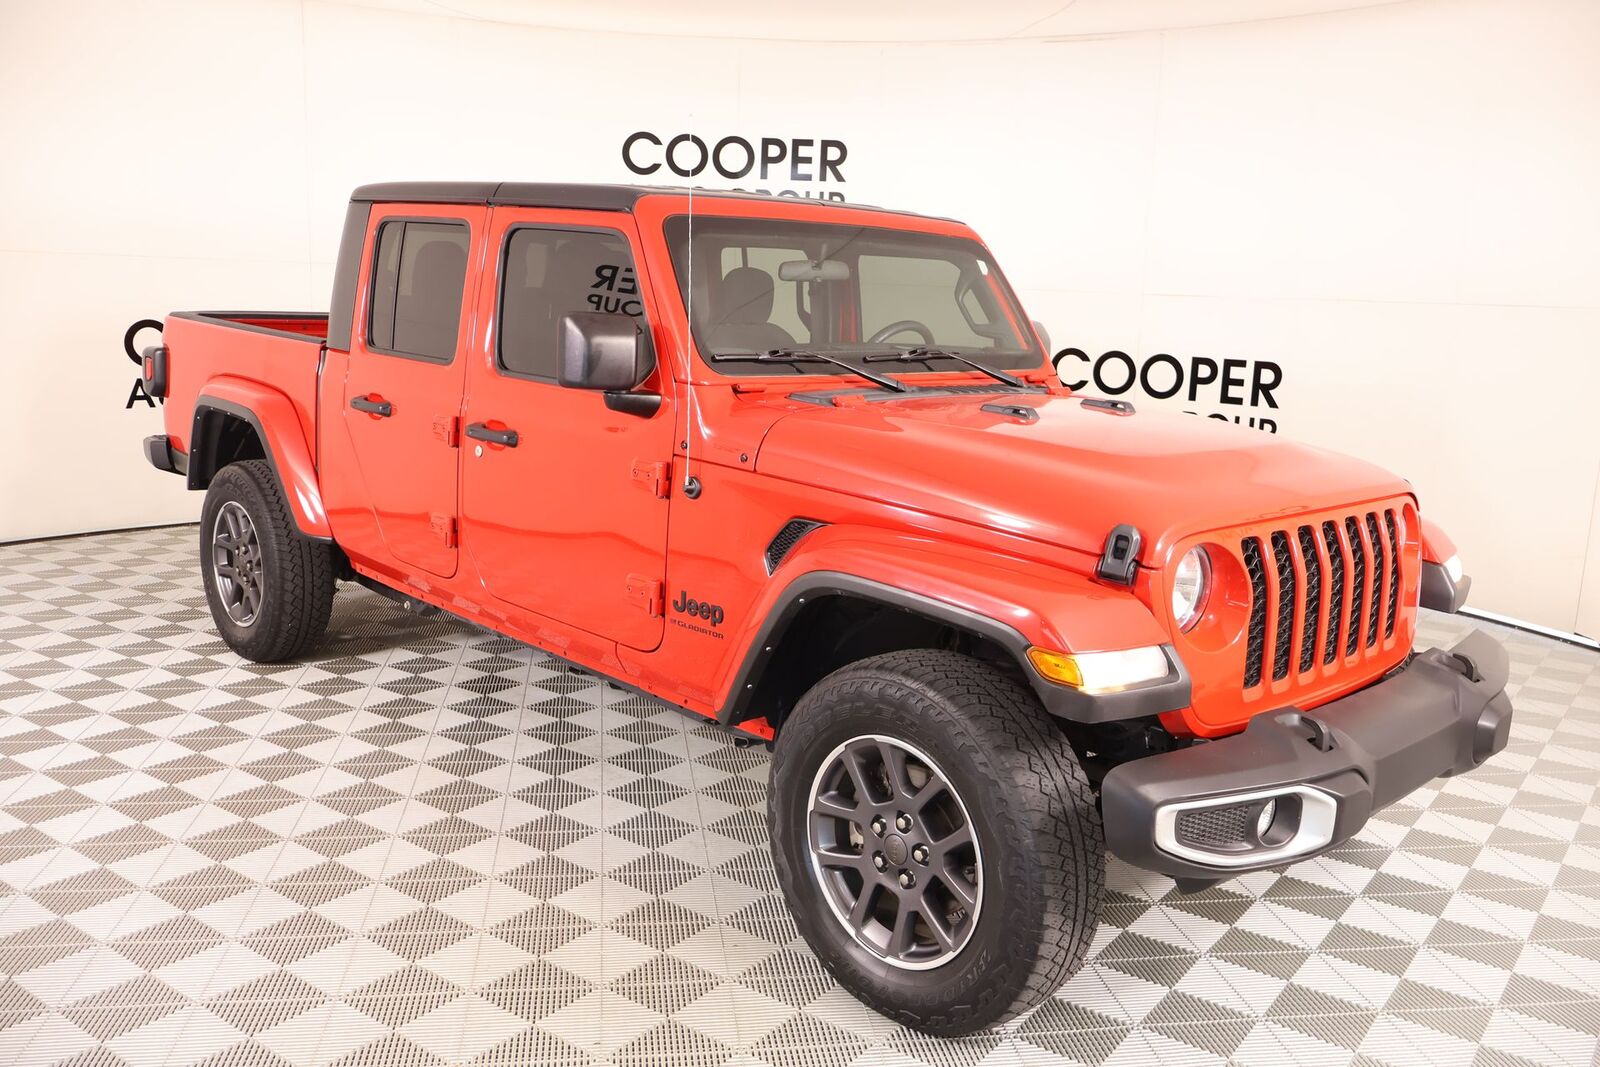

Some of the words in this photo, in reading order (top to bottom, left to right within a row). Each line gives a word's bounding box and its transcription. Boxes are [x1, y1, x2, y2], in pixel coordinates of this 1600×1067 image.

[622, 131, 848, 183] COOPER
[1052, 347, 1283, 409] COOPER
[673, 590, 724, 627] Jeep
[677, 620, 724, 639] GLADIATOR
